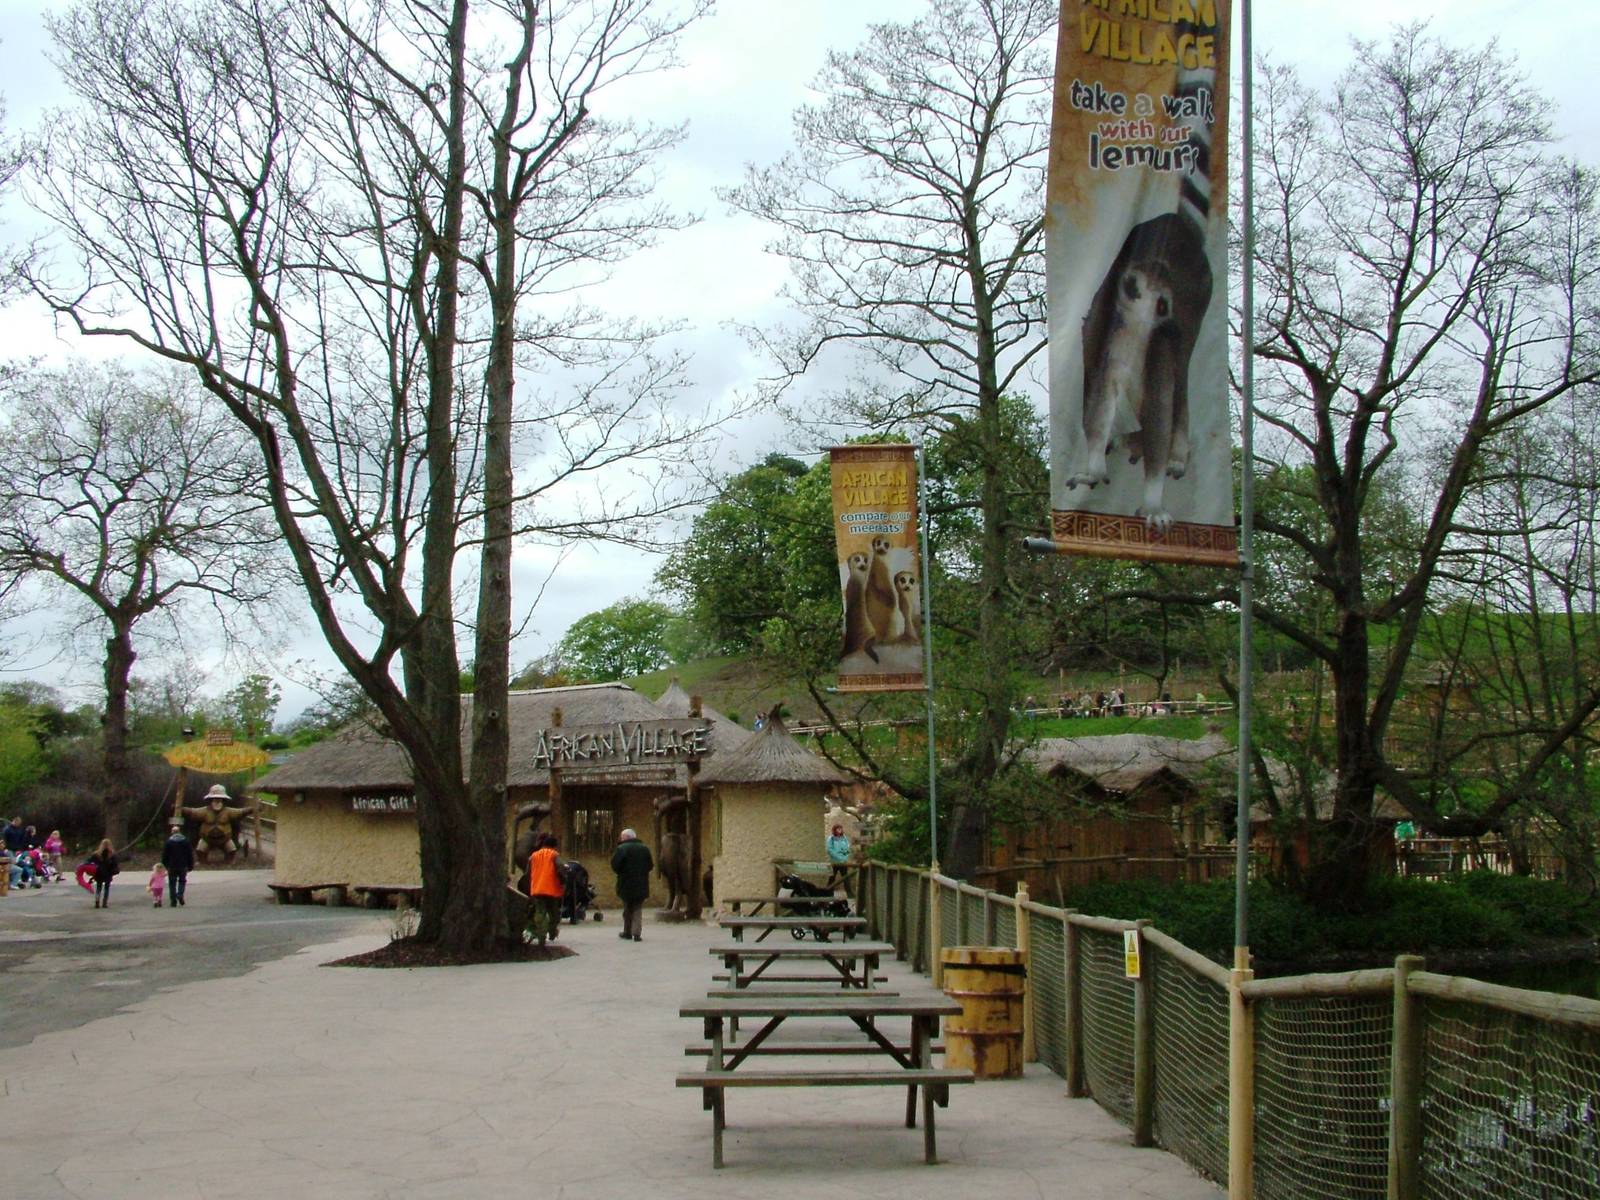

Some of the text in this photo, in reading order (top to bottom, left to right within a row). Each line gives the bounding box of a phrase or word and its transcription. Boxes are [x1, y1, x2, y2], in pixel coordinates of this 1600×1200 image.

[1083, 0, 1216, 28] ICAN
[1079, 10, 1216, 71] VILLAGE
[1070, 79, 1215, 123] take a walk
[1098, 118, 1192, 143] with our
[1088, 132, 1200, 176] lemurs
[842, 469, 907, 488] AFRICAN
[843, 489, 908, 507] VILLAGE
[839, 511, 889, 524] compare
[532, 723, 708, 769] AFRICAN VILLAGE
[352, 796, 386, 810] African
[389, 796, 408, 810] Gift
